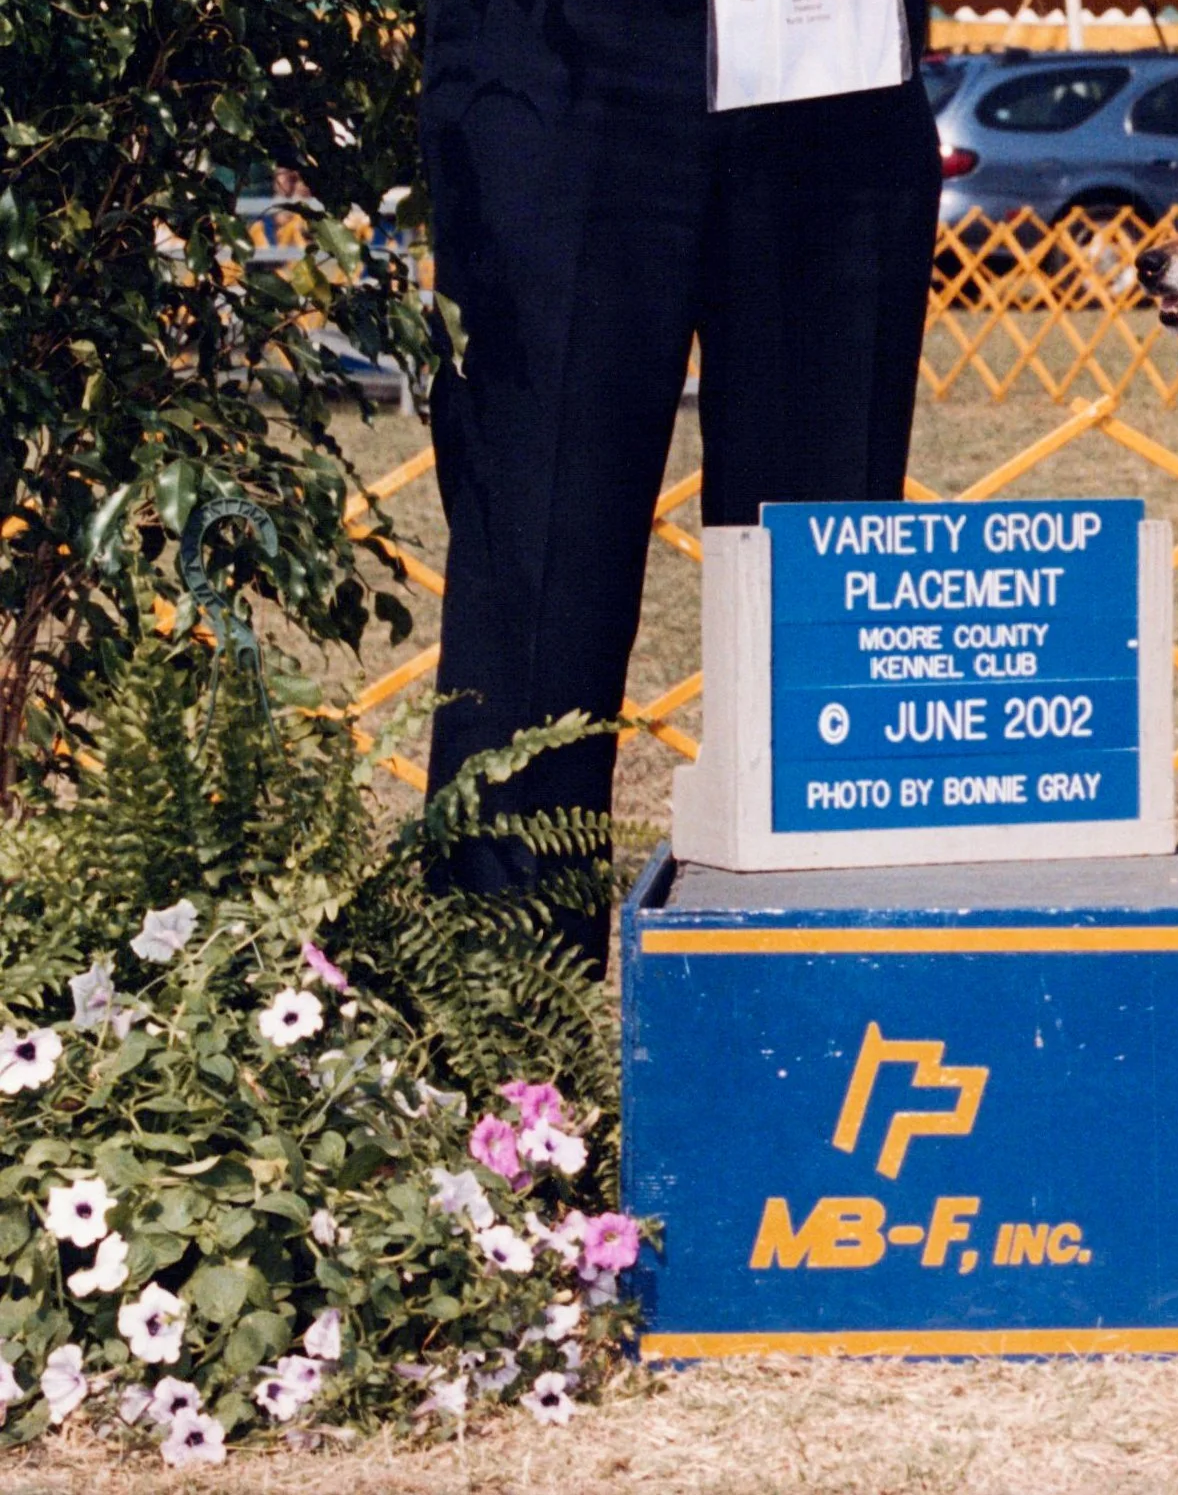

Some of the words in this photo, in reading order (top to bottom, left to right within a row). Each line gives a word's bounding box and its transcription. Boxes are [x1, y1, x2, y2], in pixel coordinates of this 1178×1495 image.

[809, 514, 966, 555] VARIETY
[984, 511, 1101, 553] GROUP
[845, 567, 1064, 611] PLACEMENT
[858, 625, 942, 652] MOORE
[954, 623, 1049, 649] COUNTY
[870, 655, 964, 680] KENNEL
[973, 652, 1038, 677] CLUB
[884, 699, 987, 743] JUNE
[1004, 696, 1093, 739] 2002
[807, 780, 891, 809] PHOTO
[900, 779, 934, 807] BY
[943, 775, 1028, 806] BONNIE
[1037, 773, 1101, 803] GRAY
[750, 1197, 979, 1274] MB-F,
[994, 1223, 1091, 1265] INC.
